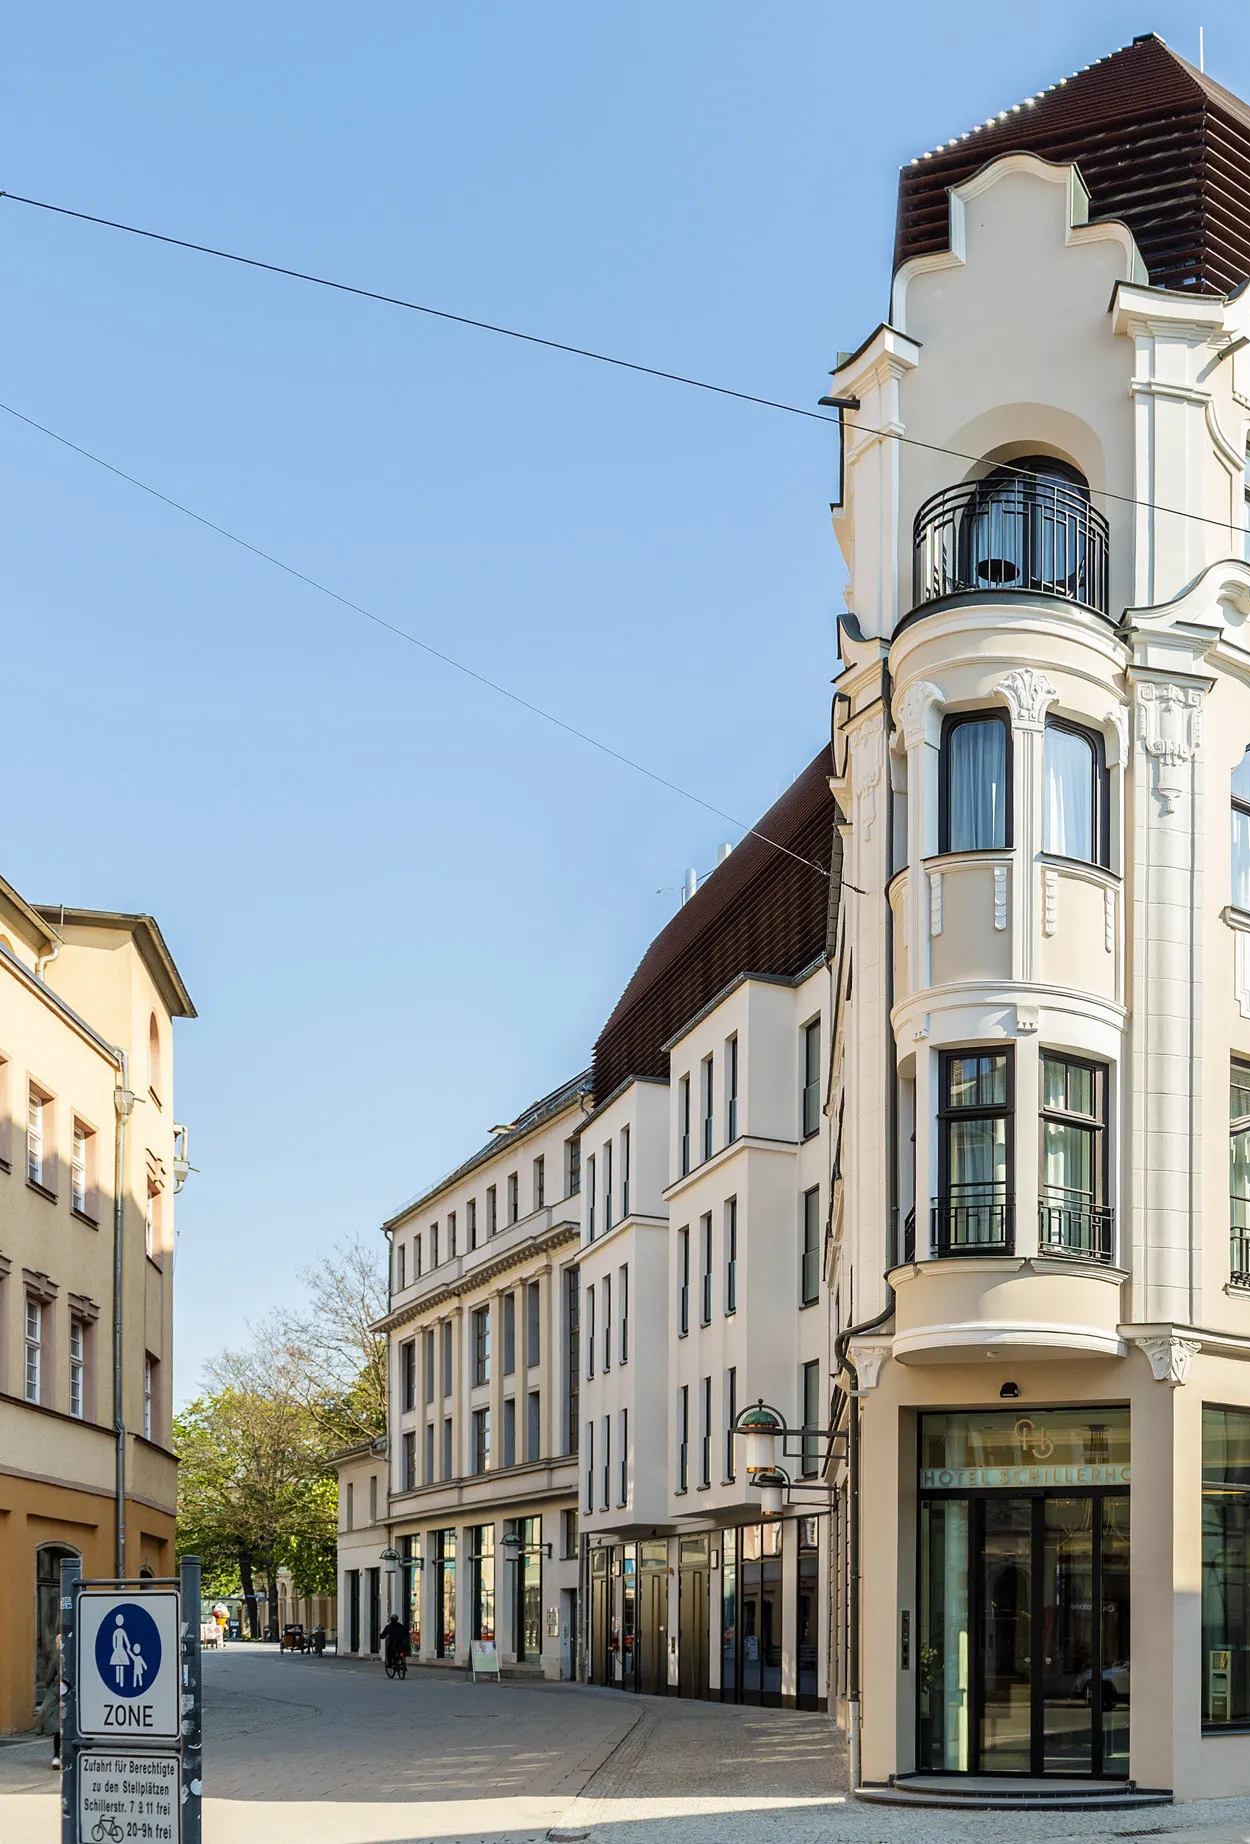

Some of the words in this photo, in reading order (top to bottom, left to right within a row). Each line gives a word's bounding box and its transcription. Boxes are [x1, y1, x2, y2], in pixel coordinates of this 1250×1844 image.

[923, 1470, 988, 1486] HOTEL
[103, 1704, 154, 1727] ZONE
[83, 1760, 112, 1773] Zufahrt
[114, 1760, 127, 1774] für
[129, 1761, 175, 1778] Berechtigte
[92, 1782, 102, 1792] zu
[104, 1780, 119, 1794] den
[122, 1780, 170, 1797] Stellplätzen
[83, 1798, 127, 1813] Schillerstr.
[129, 1800, 135, 1813] 7
[146, 1801, 153, 1815] 11
[156, 1802, 171, 1816] frei
[126, 1822, 153, 1838] 20-9h
[155, 1823, 172, 1840] frei
